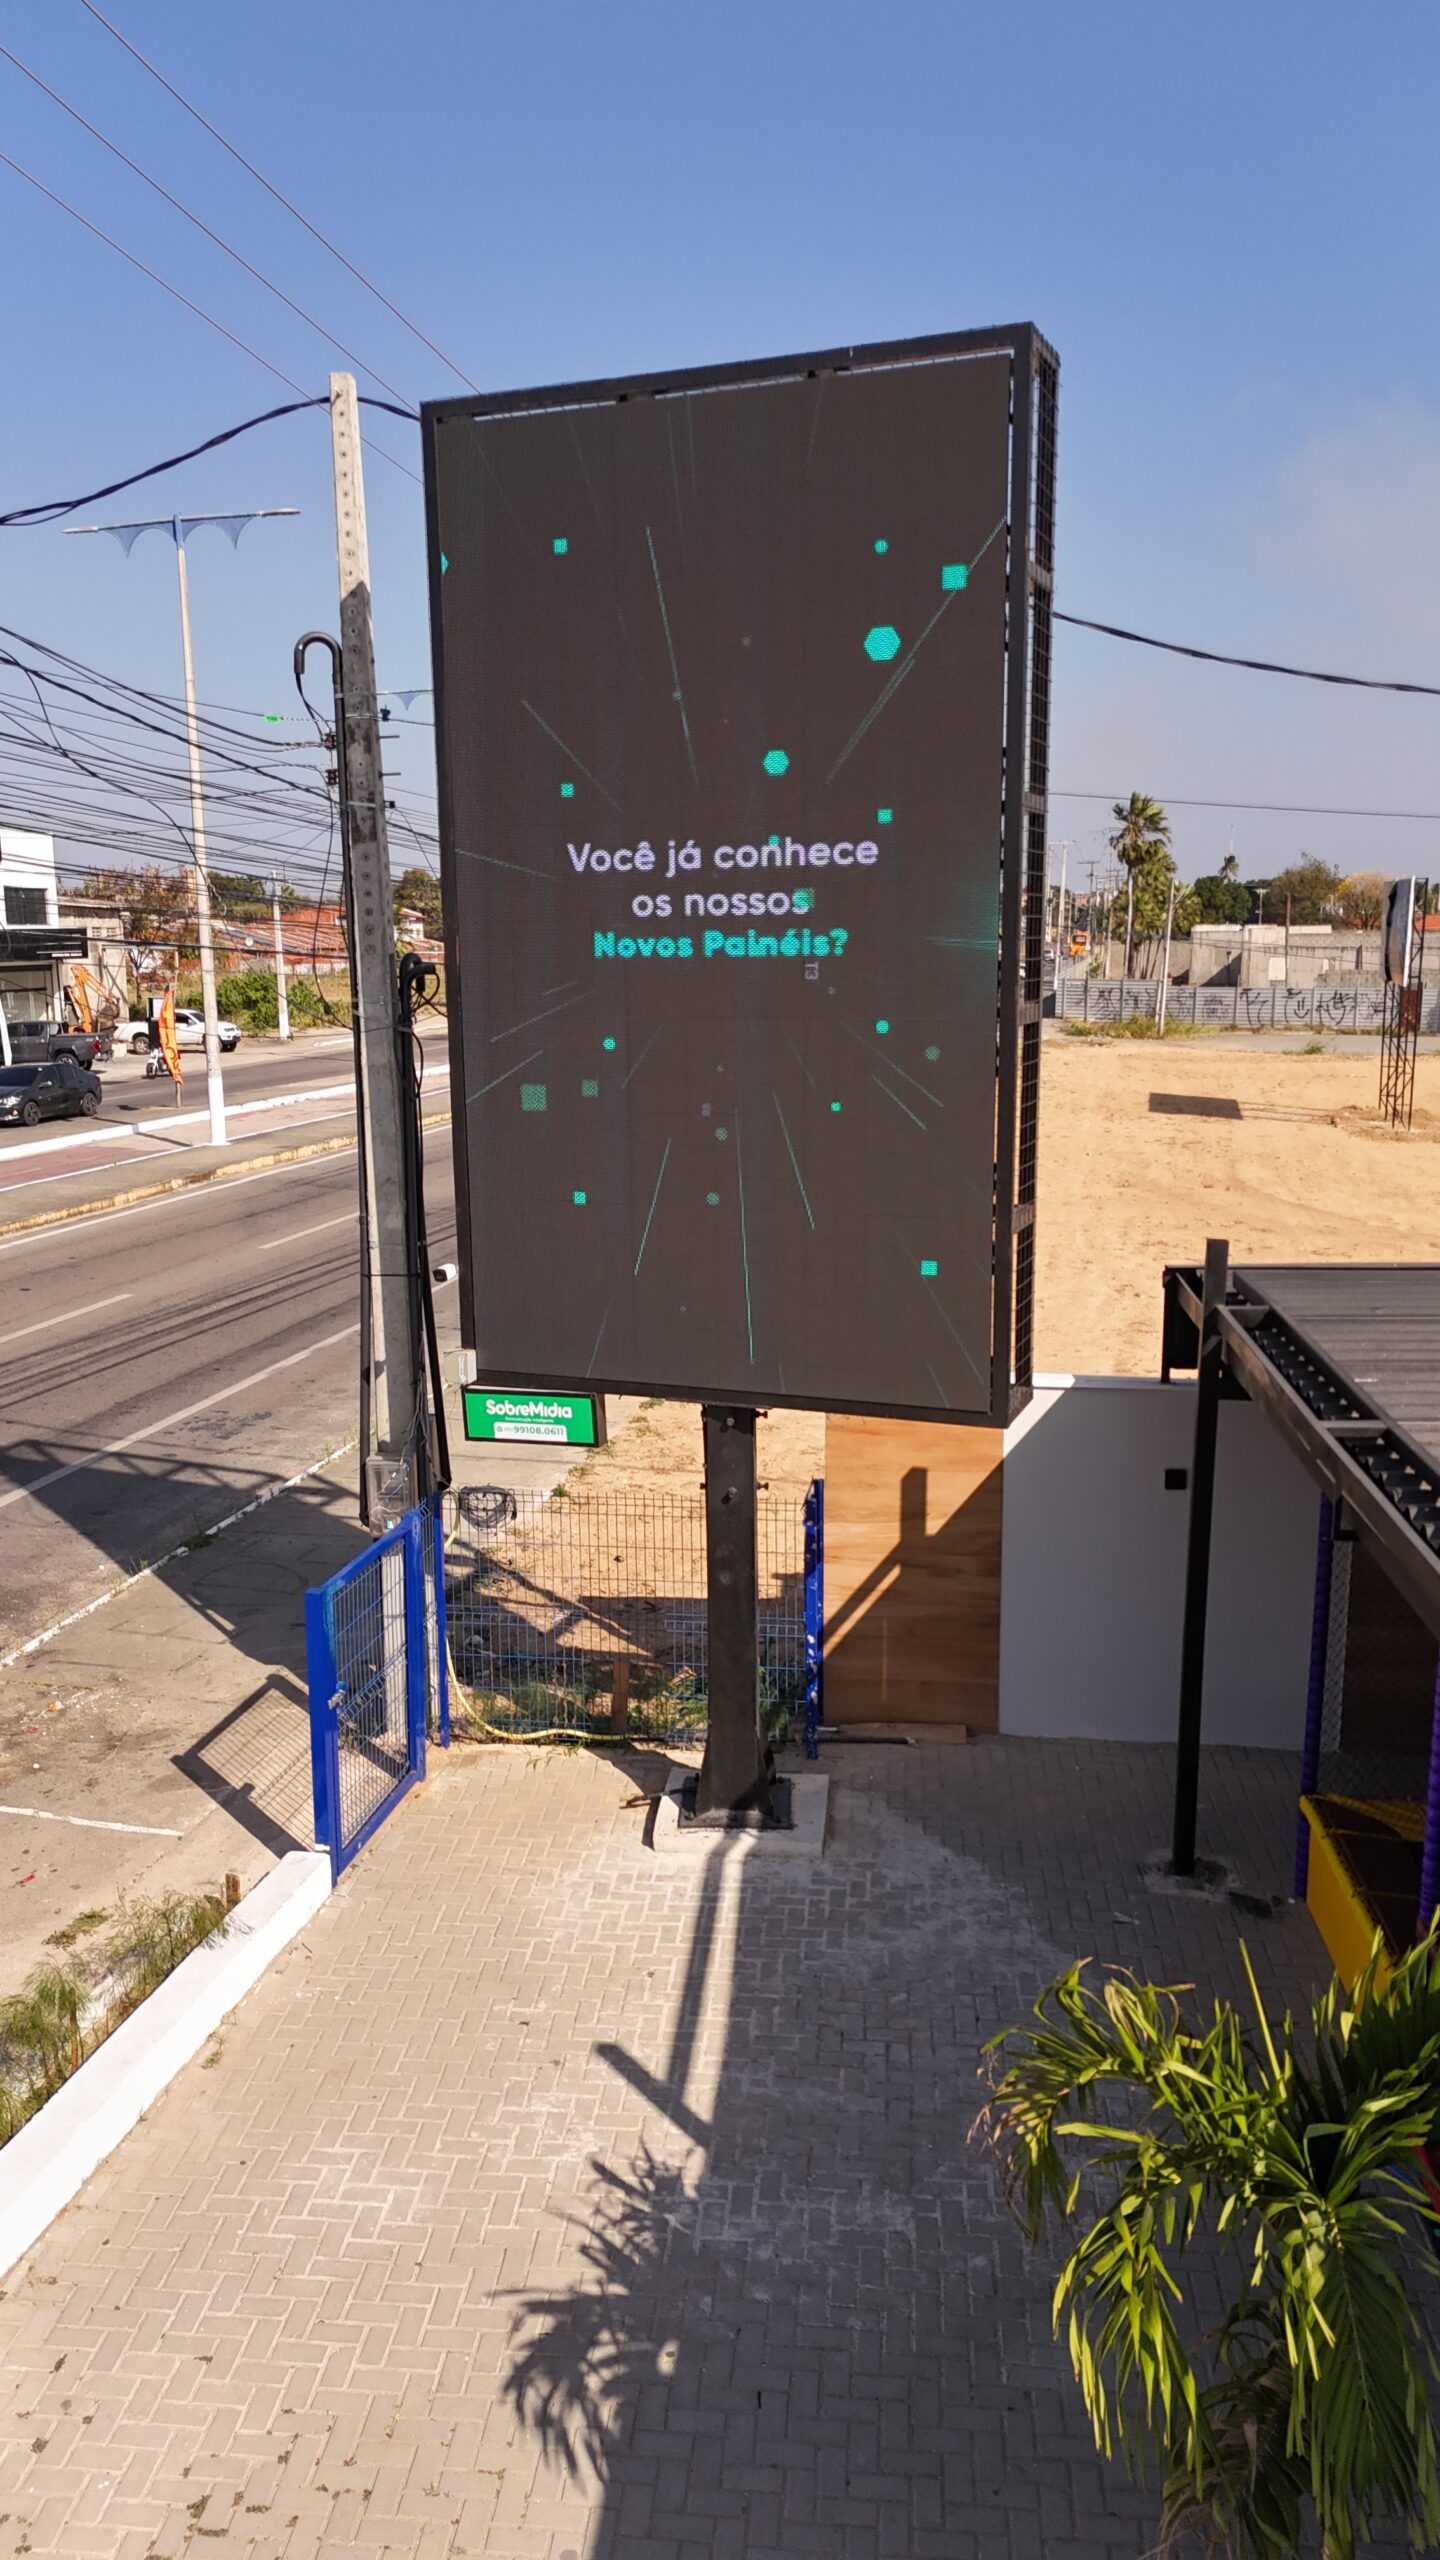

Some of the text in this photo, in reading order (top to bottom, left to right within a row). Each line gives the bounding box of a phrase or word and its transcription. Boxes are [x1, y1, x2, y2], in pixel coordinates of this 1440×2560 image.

[566, 836, 879, 878] Você já conhece
[631, 894, 672, 917] os
[593, 927, 848, 958] Novos Painéis?
[485, 1399, 572, 1418] SobreMidia
